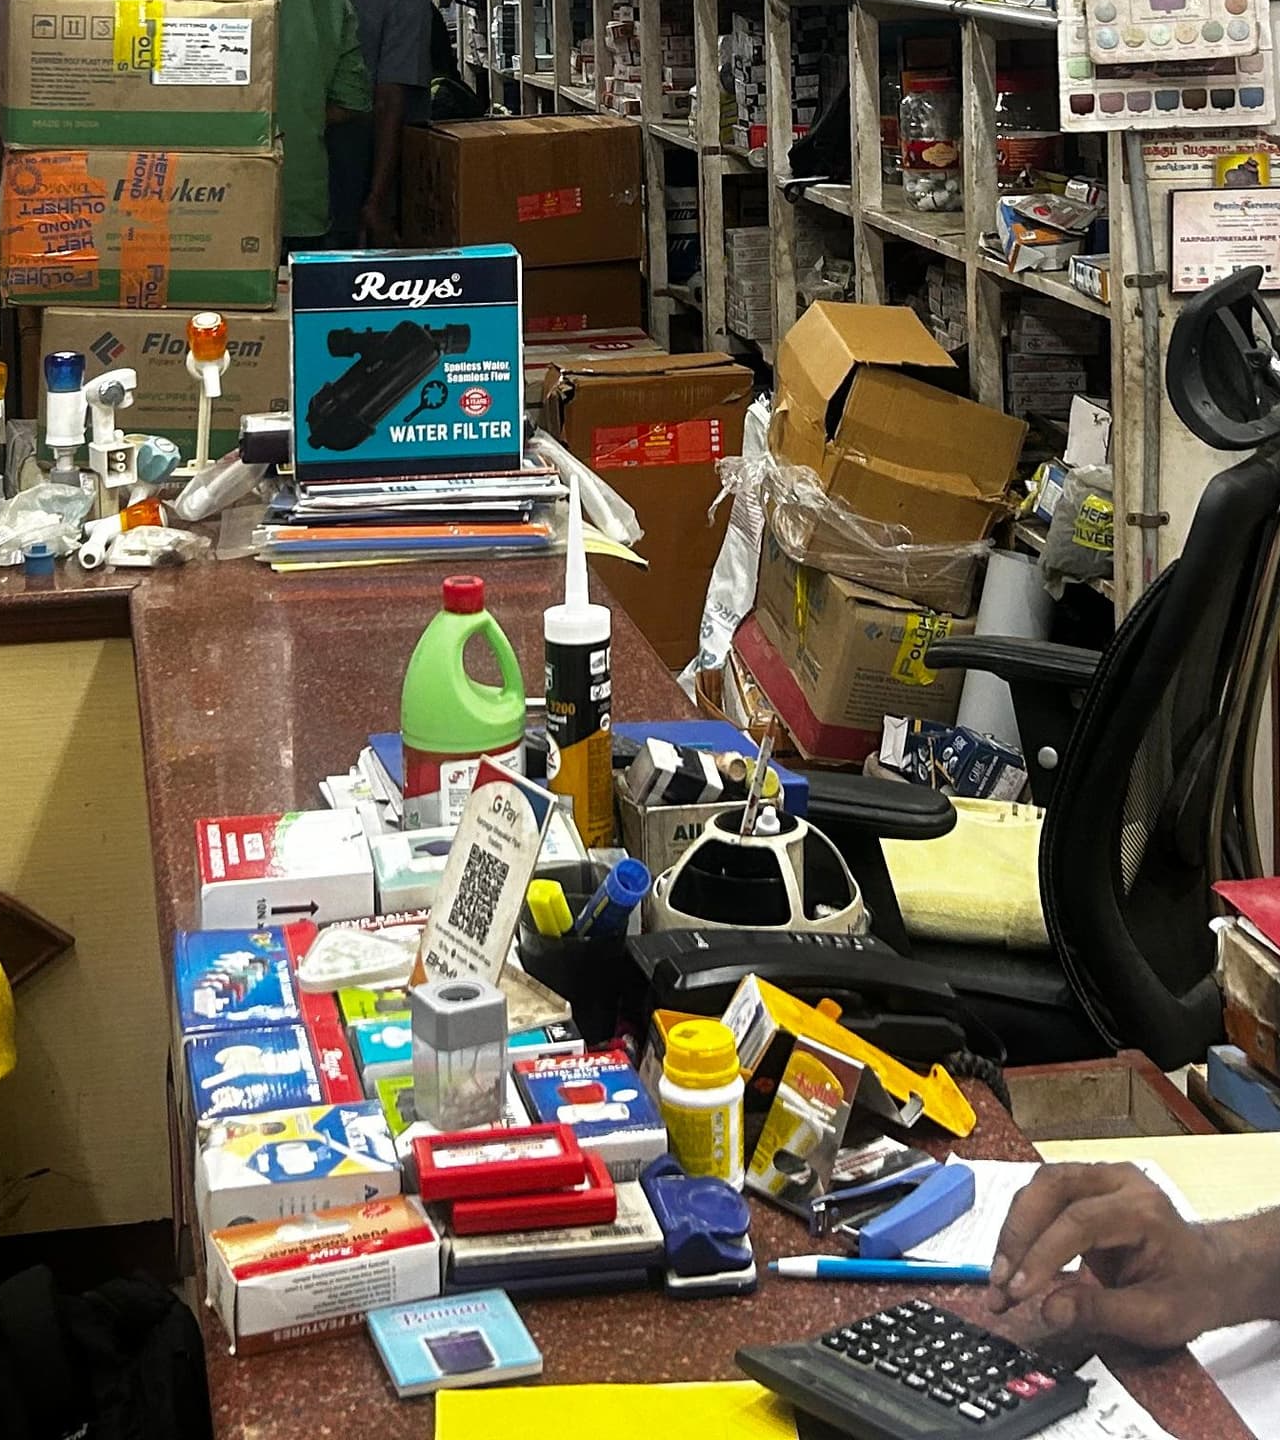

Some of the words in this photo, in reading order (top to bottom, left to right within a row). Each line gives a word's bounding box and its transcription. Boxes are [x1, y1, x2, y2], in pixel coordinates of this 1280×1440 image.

[352, 271, 463, 308] Rays
[444, 362, 481, 373] Spotless
[447, 373, 489, 383] Seamless
[491, 371, 510, 381] Flow
[389, 424, 448, 442] WATER
[453, 421, 511, 439] FILTER
[501, 801, 521, 828] Pay
[274, 1317, 347, 1340] FEATURES
